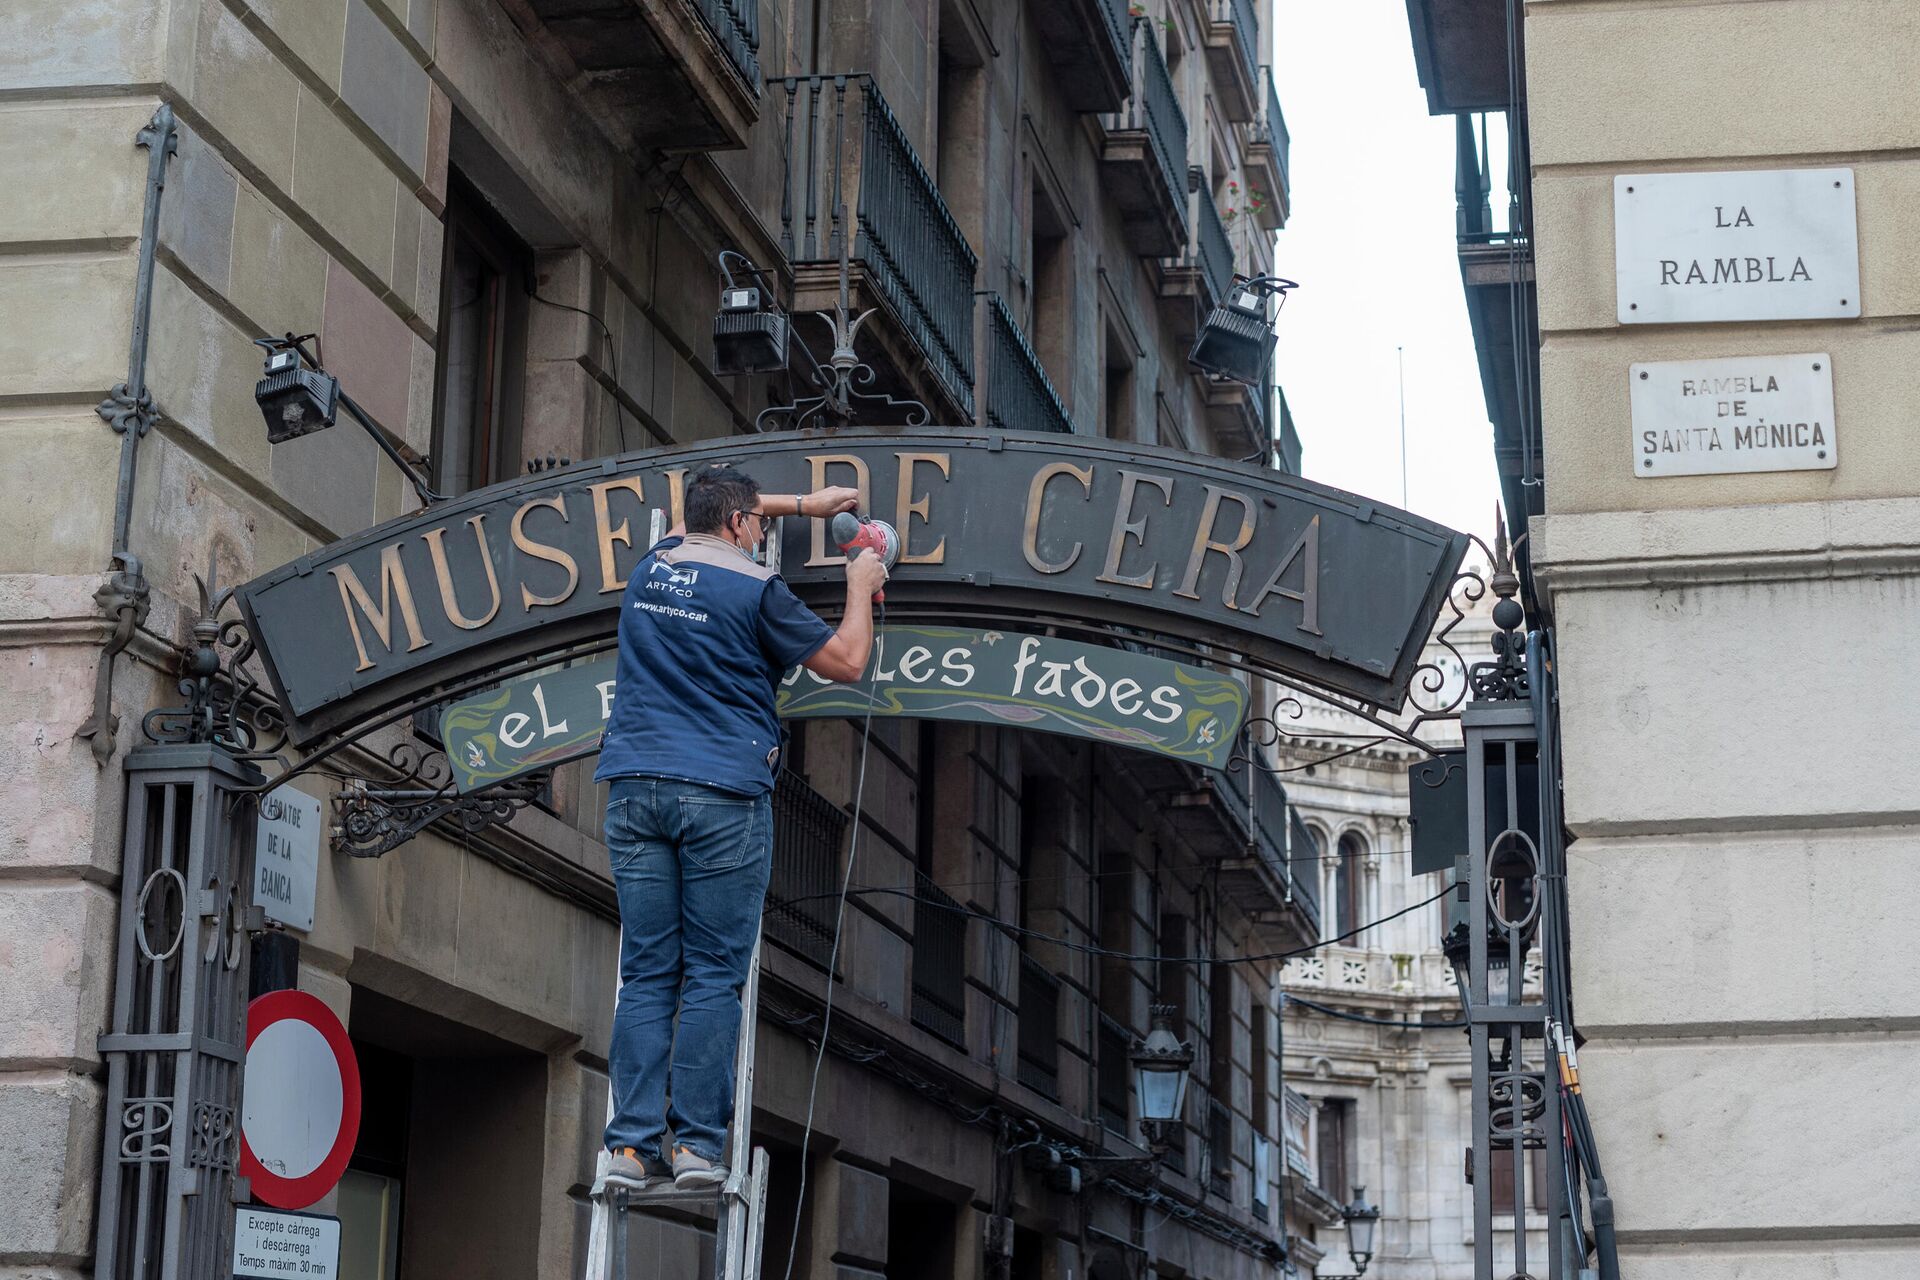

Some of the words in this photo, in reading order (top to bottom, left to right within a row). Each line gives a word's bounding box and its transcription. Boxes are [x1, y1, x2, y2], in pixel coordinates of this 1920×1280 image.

[1714, 206, 1754, 228] LA
[1660, 256, 1813, 285] RAMBLA
[1682, 375, 1779, 396] RAMBLA
[1717, 400, 1747, 417] DE
[1643, 427, 1722, 454] SANTA
[803, 452, 950, 568] DE
[1022, 461, 1323, 636] CERA
[646, 581, 693, 598] ARTYCO
[633, 601, 708, 623] www.artyco.cat
[267, 832, 277, 855] DE
[281, 837, 291, 861] LA
[260, 867, 292, 904] BANCA
[248, 1216, 284, 1234] Excepte
[287, 1221, 320, 1239] càrrega
[255, 1236, 259, 1248] i
[262, 1237, 310, 1257] descàrrega
[239, 1253, 265, 1270] Temps
[268, 1257, 297, 1271] màxim
[299, 1260, 310, 1273] 30
[311, 1262, 326, 1274] min
